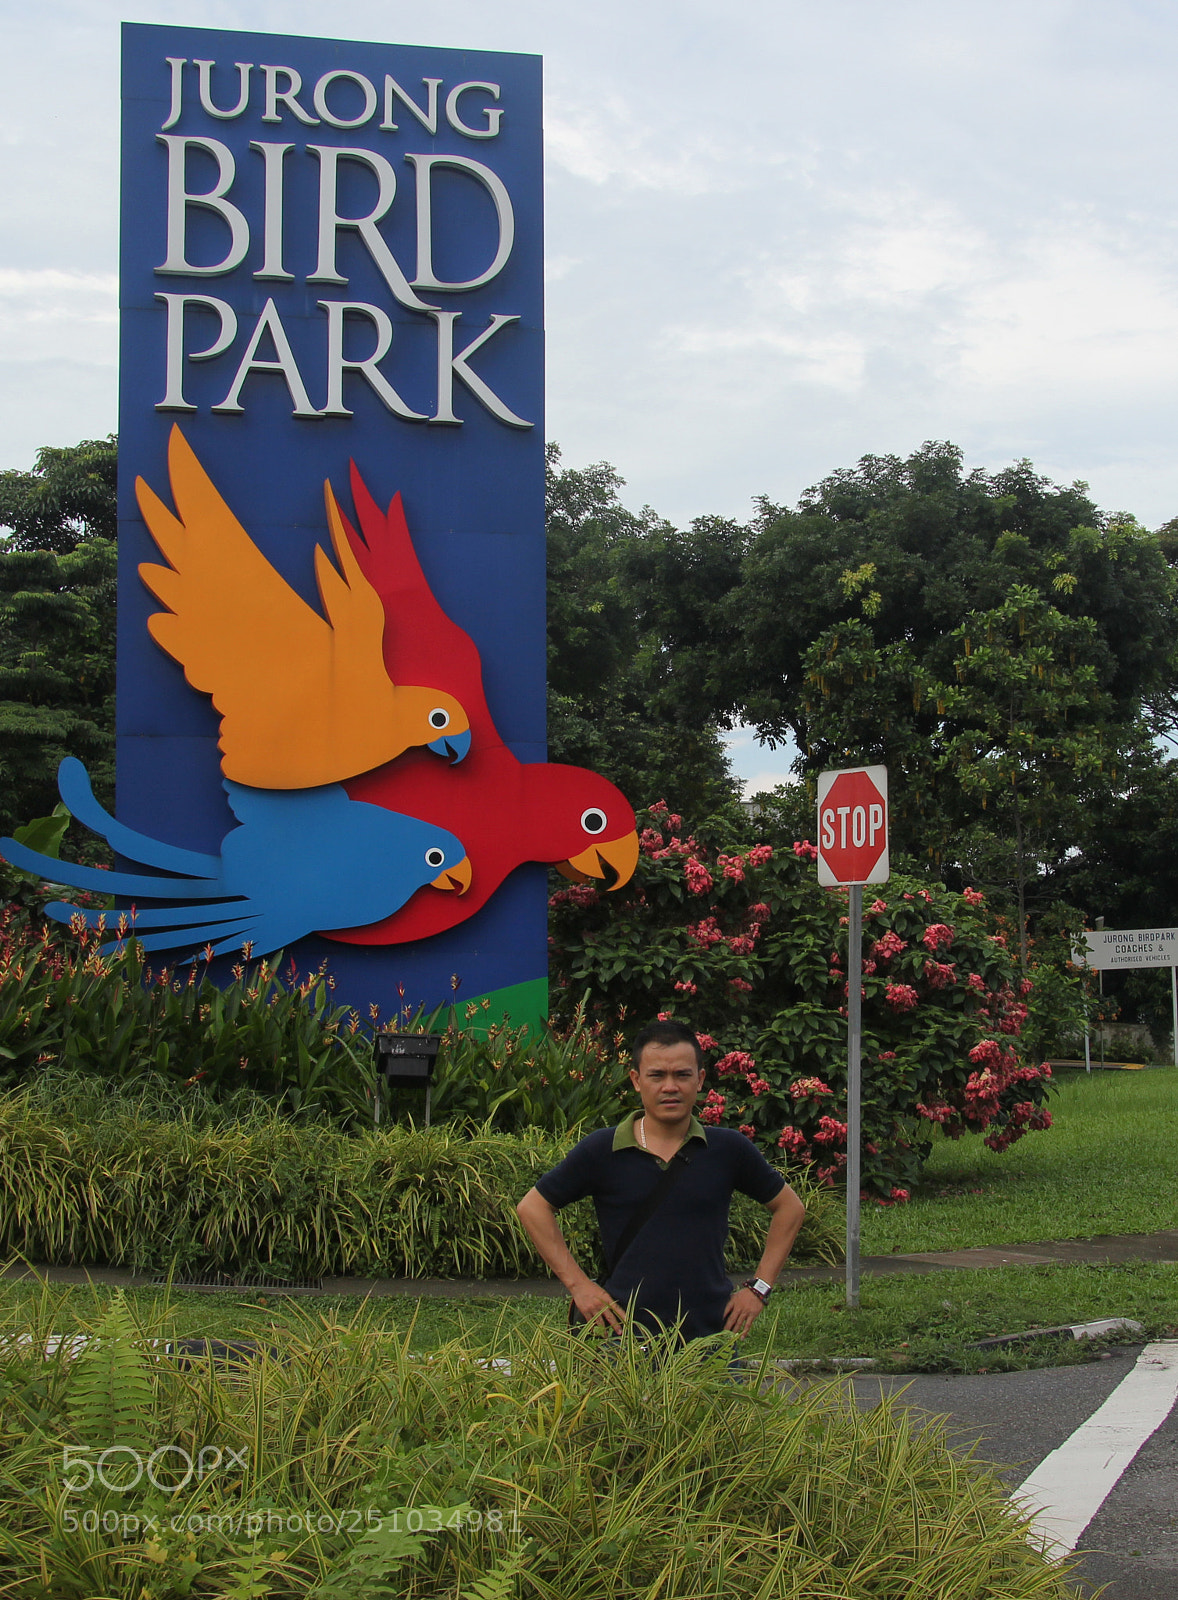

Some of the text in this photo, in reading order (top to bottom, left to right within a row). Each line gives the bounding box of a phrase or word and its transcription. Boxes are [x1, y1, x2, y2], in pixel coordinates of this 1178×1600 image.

[161, 56, 505, 140] JURONG
[153, 133, 515, 312] BIRD
[153, 291, 535, 428] PARK
[821, 803, 883, 850] STOP
[1103, 932, 1175, 943] JURONG BIRDPARK
[1115, 944, 1164, 953] COACHES &
